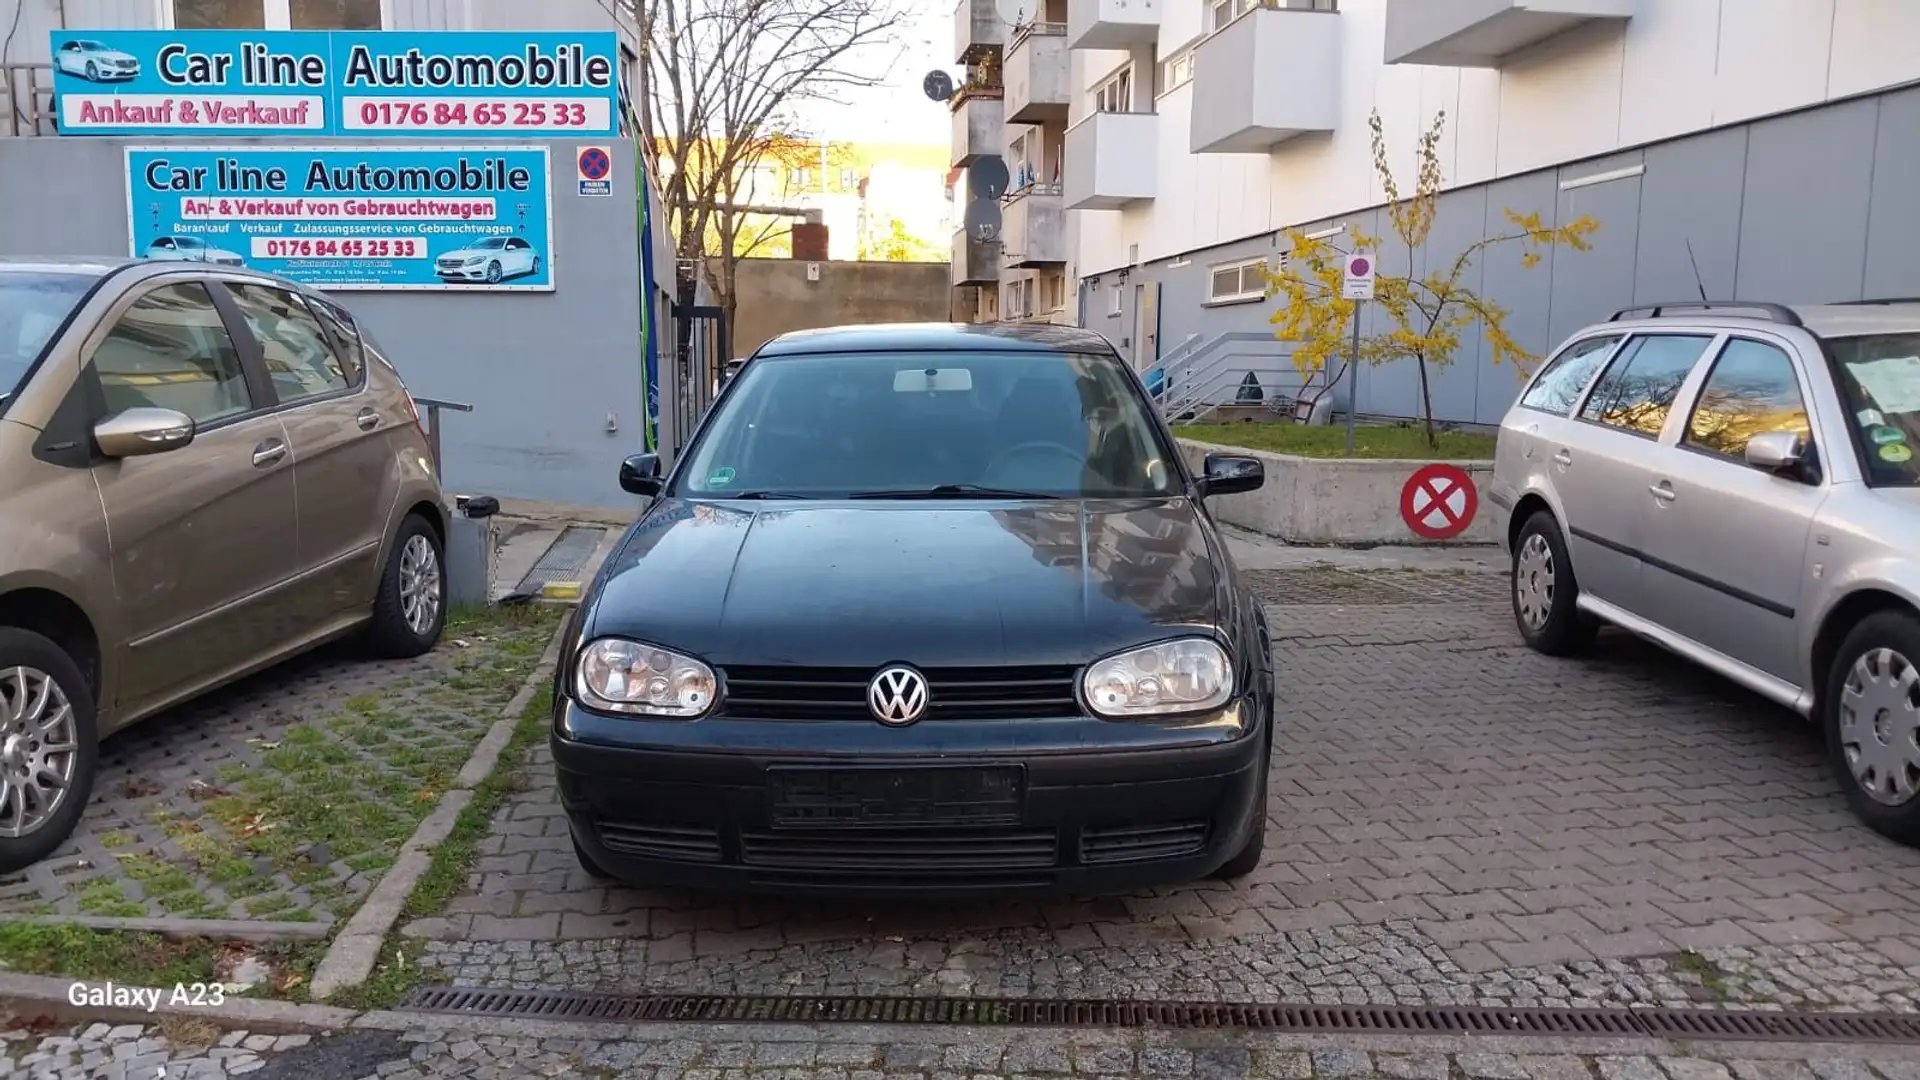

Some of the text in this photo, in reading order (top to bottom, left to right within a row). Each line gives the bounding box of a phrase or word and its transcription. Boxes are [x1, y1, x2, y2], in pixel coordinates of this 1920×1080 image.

[157, 42, 324, 86] Car line
[345, 44, 610, 87] Automobile
[80, 99, 308, 125] Ankauf & Verkauf
[361, 103, 586, 126] 0176 84 65 25 33
[146, 158, 530, 192] Car line Automobile
[184, 199, 494, 219] An- & Verkauf von Gebrauchtwagen
[173, 223, 513, 235] Barankauf Verkauf Zulassungsservice von Gebrauchtwagen
[267, 240, 415, 256] 0176 84 65 25 33
[869, 666, 927, 723] VW
